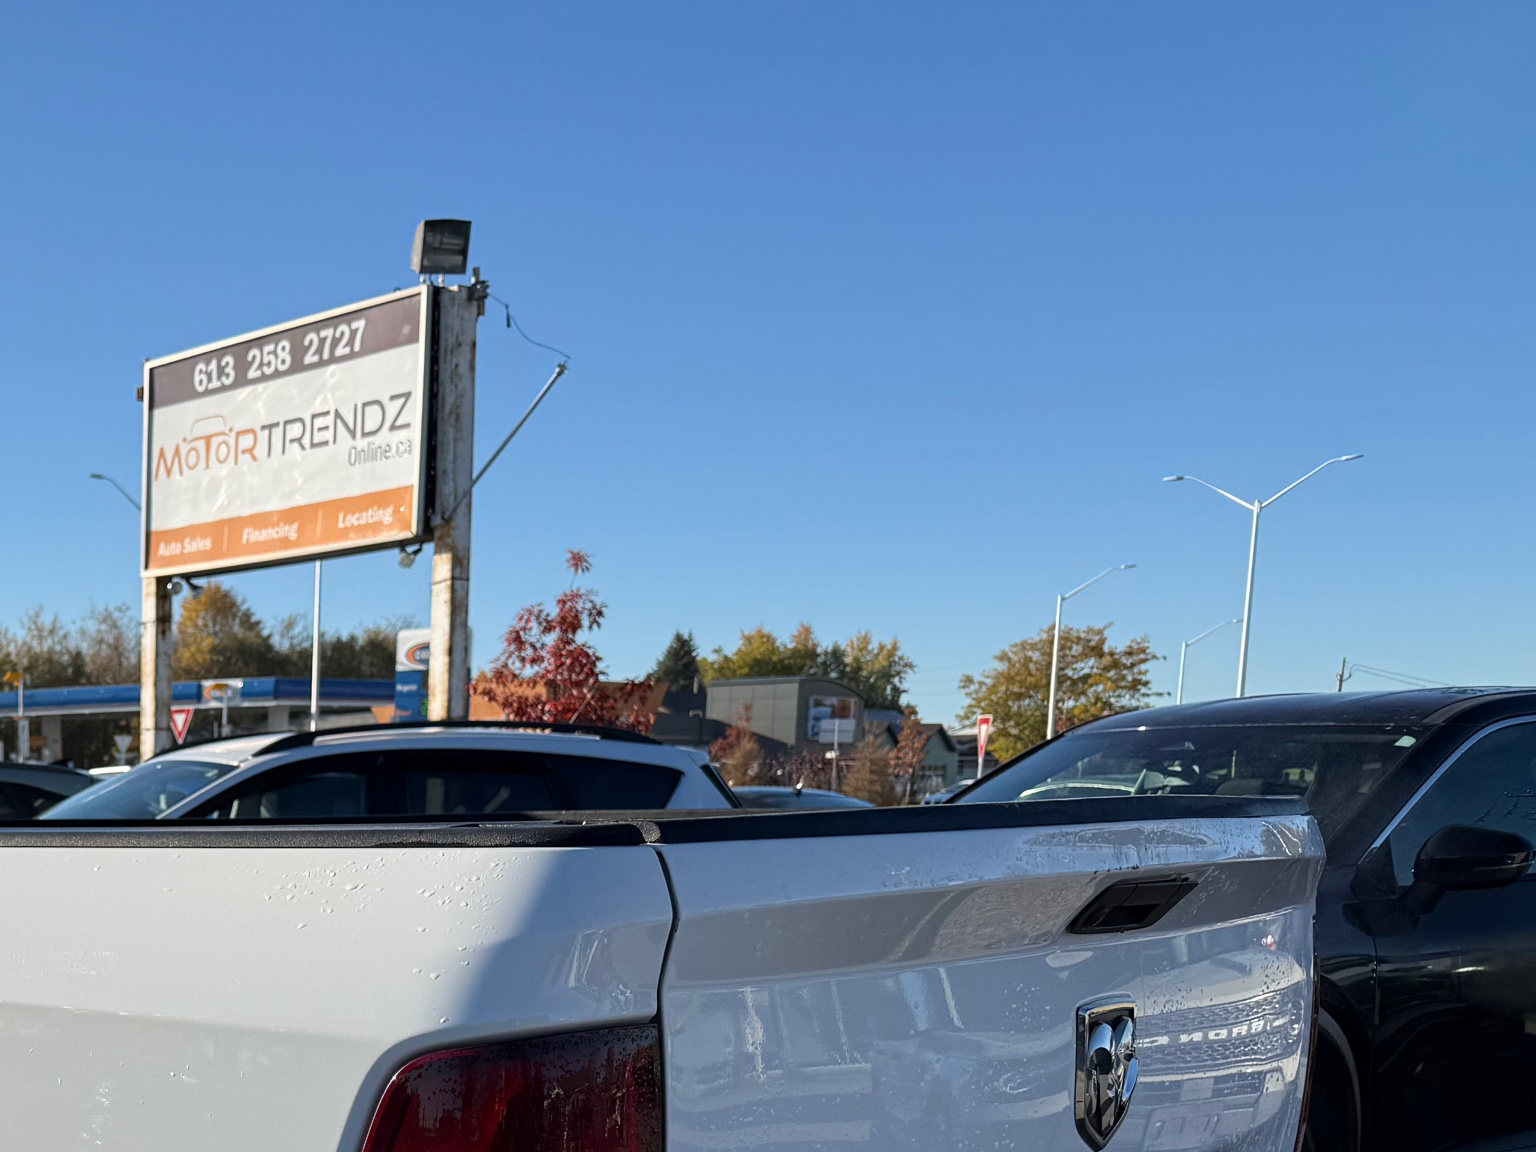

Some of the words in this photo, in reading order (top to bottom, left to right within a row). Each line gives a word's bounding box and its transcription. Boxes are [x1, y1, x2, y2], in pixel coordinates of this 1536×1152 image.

[193, 353, 235, 393] 613
[247, 339, 291, 380] 258
[303, 318, 366, 366] 2727
[347, 438, 412, 467] Online.ca
[338, 504, 394, 529] Locating
[242, 521, 300, 545] Financing
[157, 541, 182, 557] Auto
[183, 536, 212, 554] Sales
